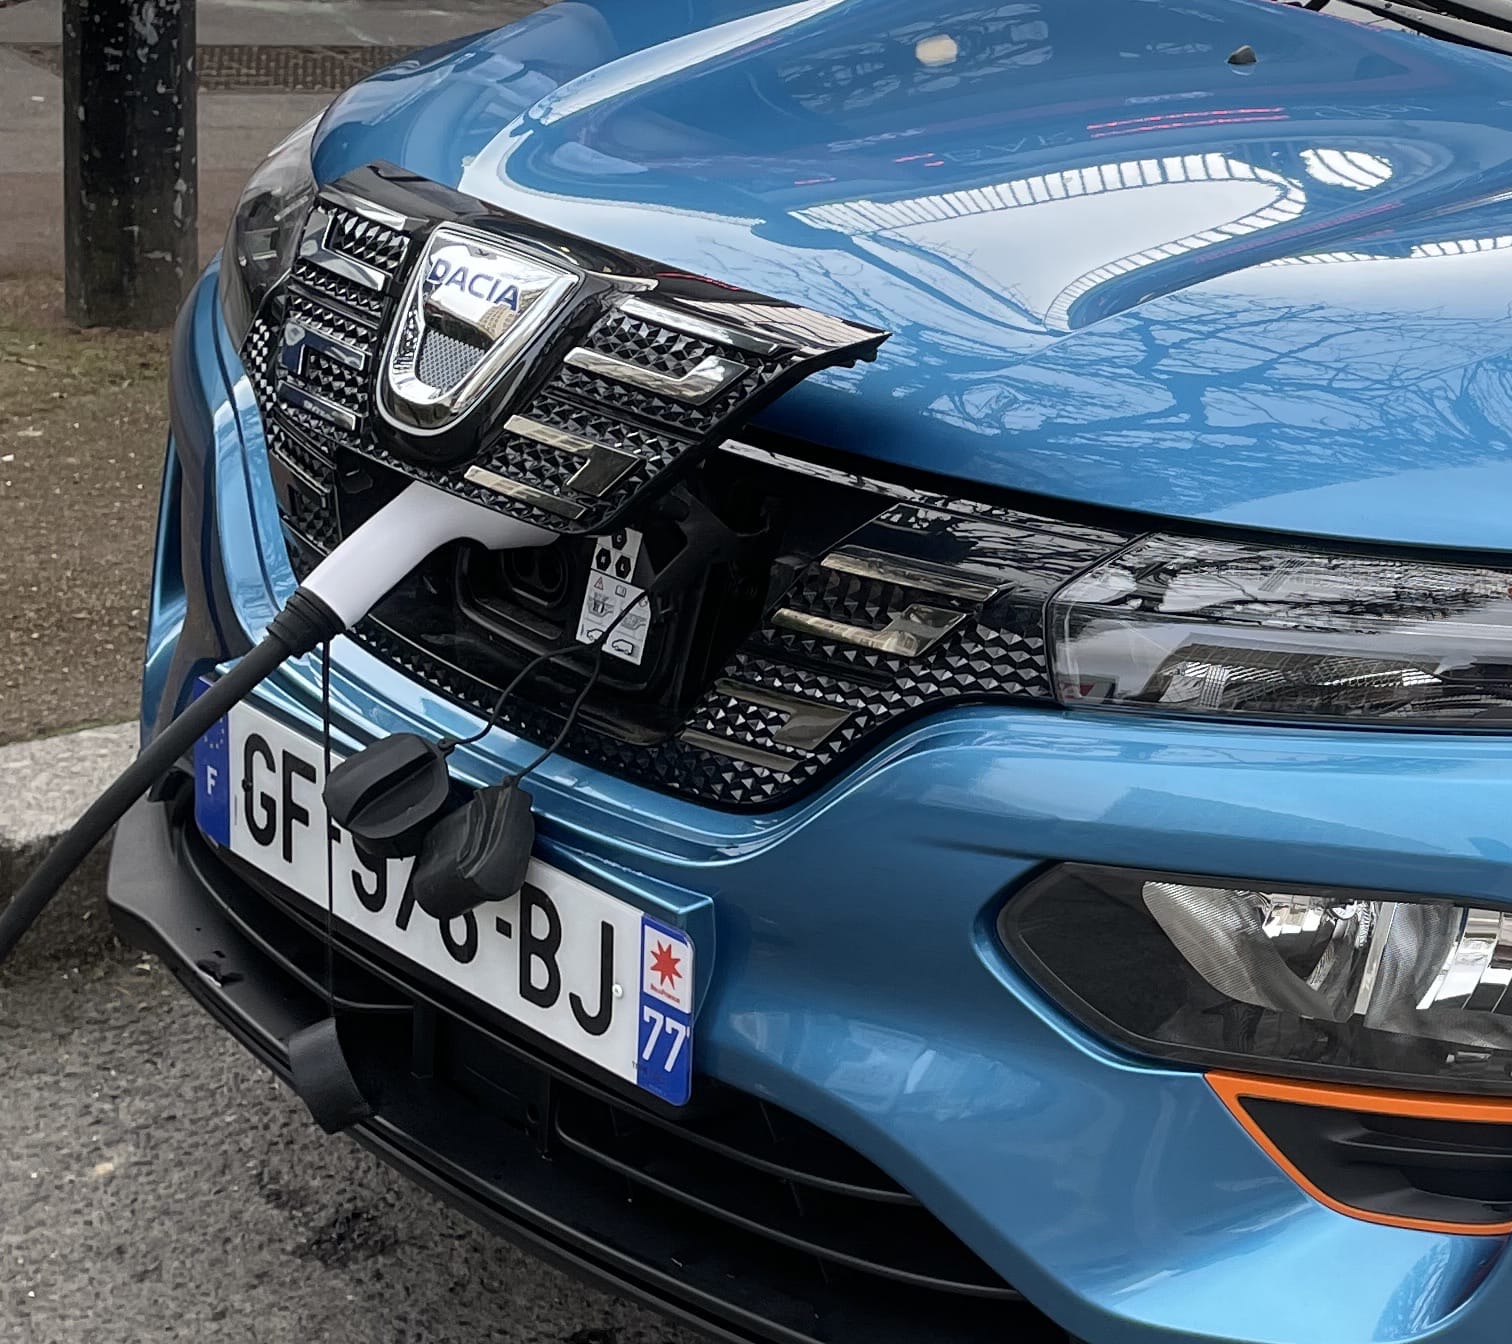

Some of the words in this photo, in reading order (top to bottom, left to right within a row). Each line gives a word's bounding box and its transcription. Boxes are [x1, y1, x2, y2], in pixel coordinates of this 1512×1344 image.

[428, 257, 522, 313] DACIA
[206, 764, 218, 795] F
[642, 1005, 687, 1073] 77
